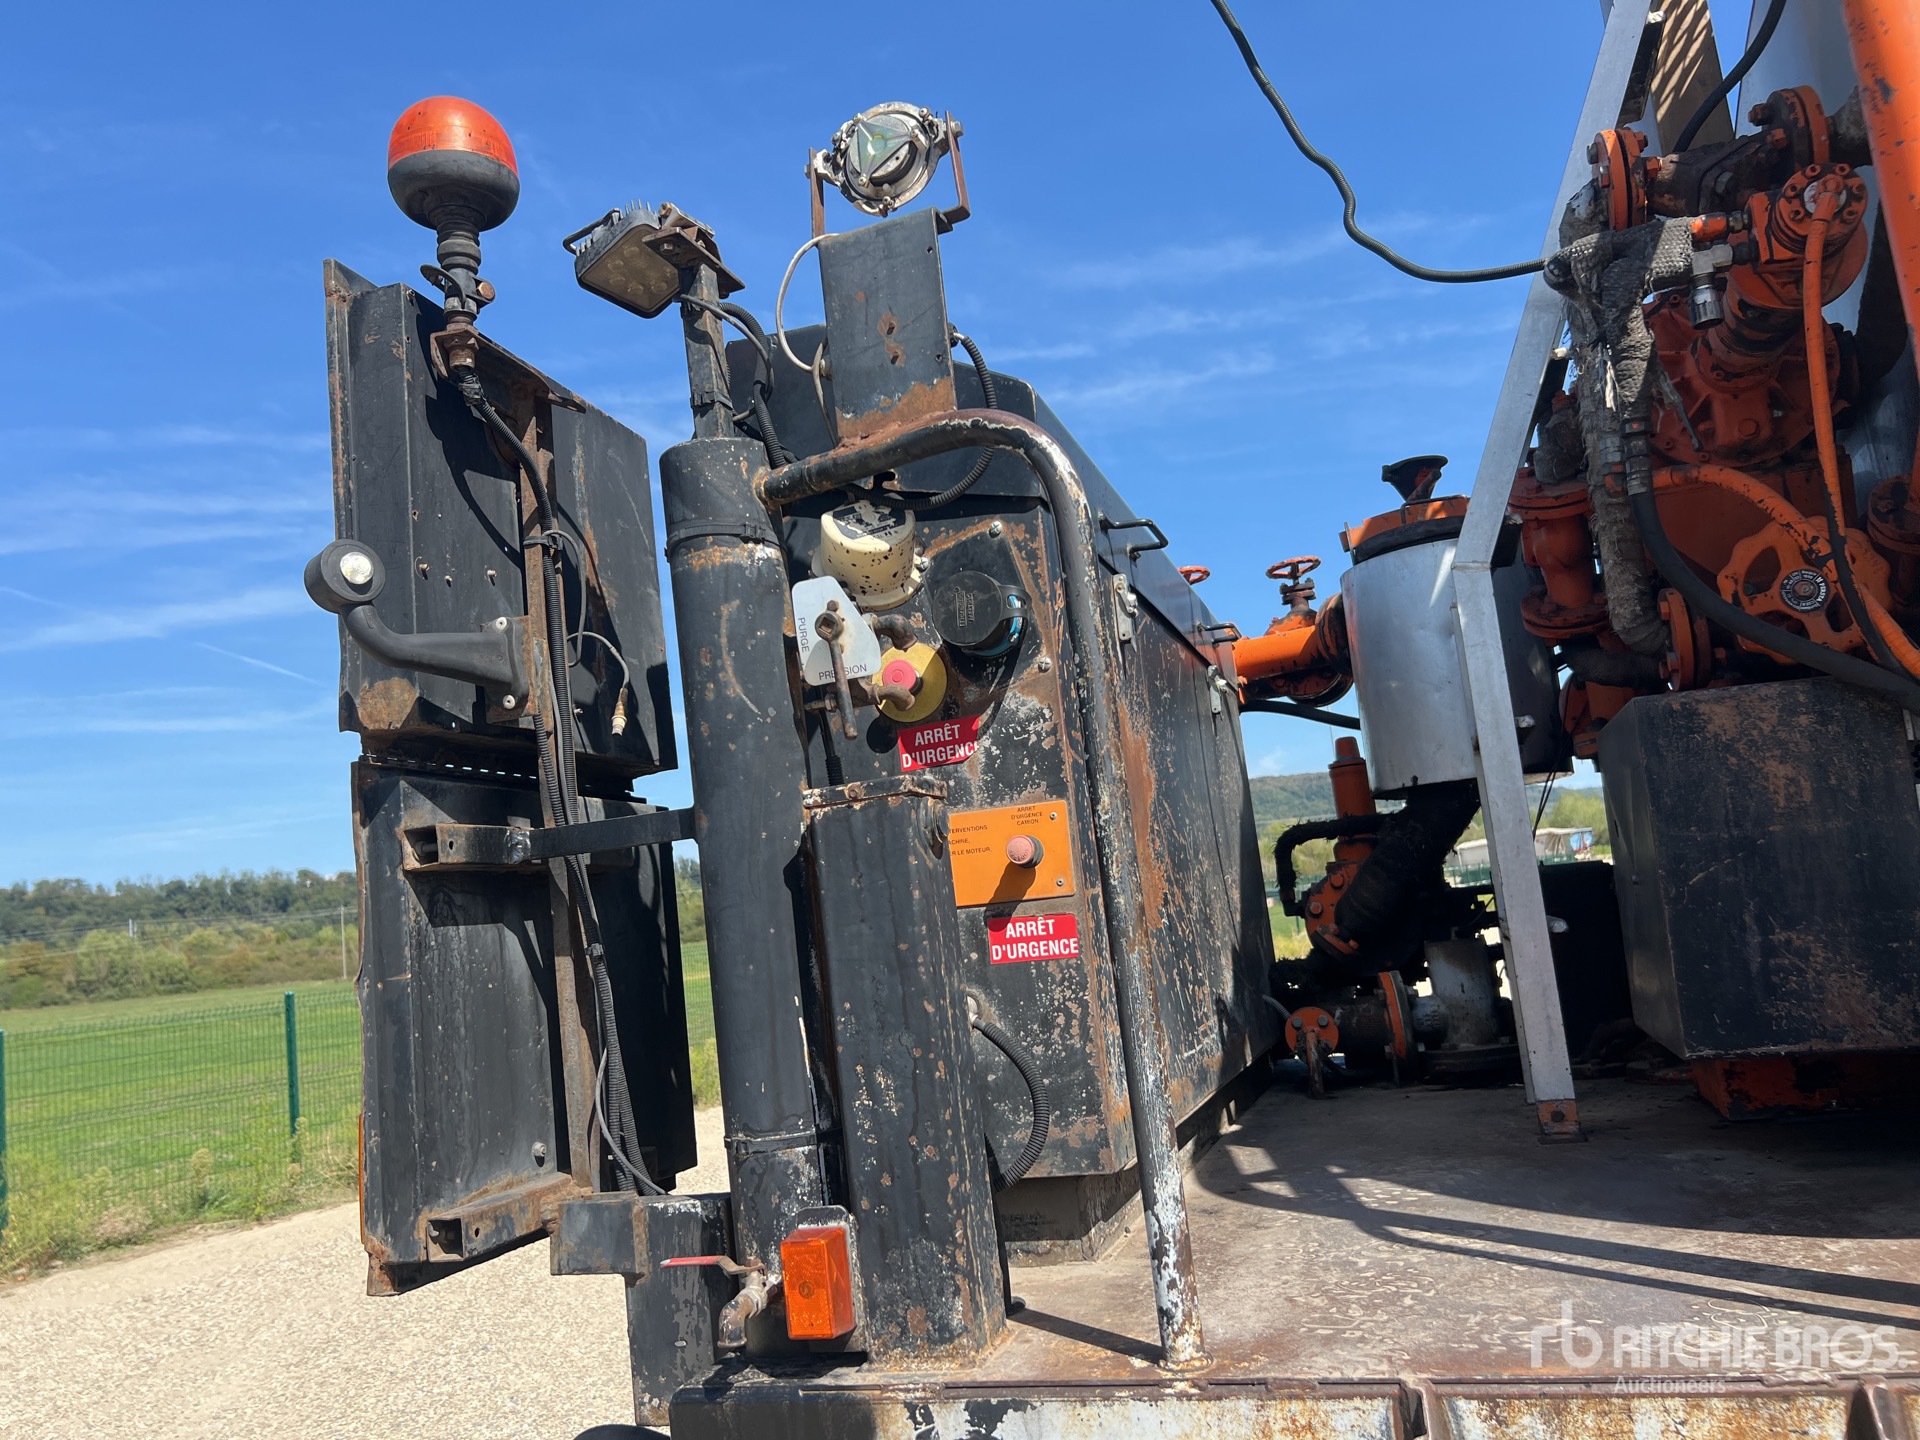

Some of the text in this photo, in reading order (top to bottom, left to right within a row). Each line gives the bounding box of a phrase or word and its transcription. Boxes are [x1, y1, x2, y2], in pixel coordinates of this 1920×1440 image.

[797, 617, 810, 653] PURGE
[818, 663, 867, 681] PRESION
[915, 723, 960, 747] ARRÊT
[1011, 811, 1043, 820] D'URGENCE
[1017, 805, 1036, 813] ARRET
[957, 848, 965, 856] LE
[1005, 916, 1055, 939] ARRÊT
[991, 937, 1079, 961] D'URGENCE
